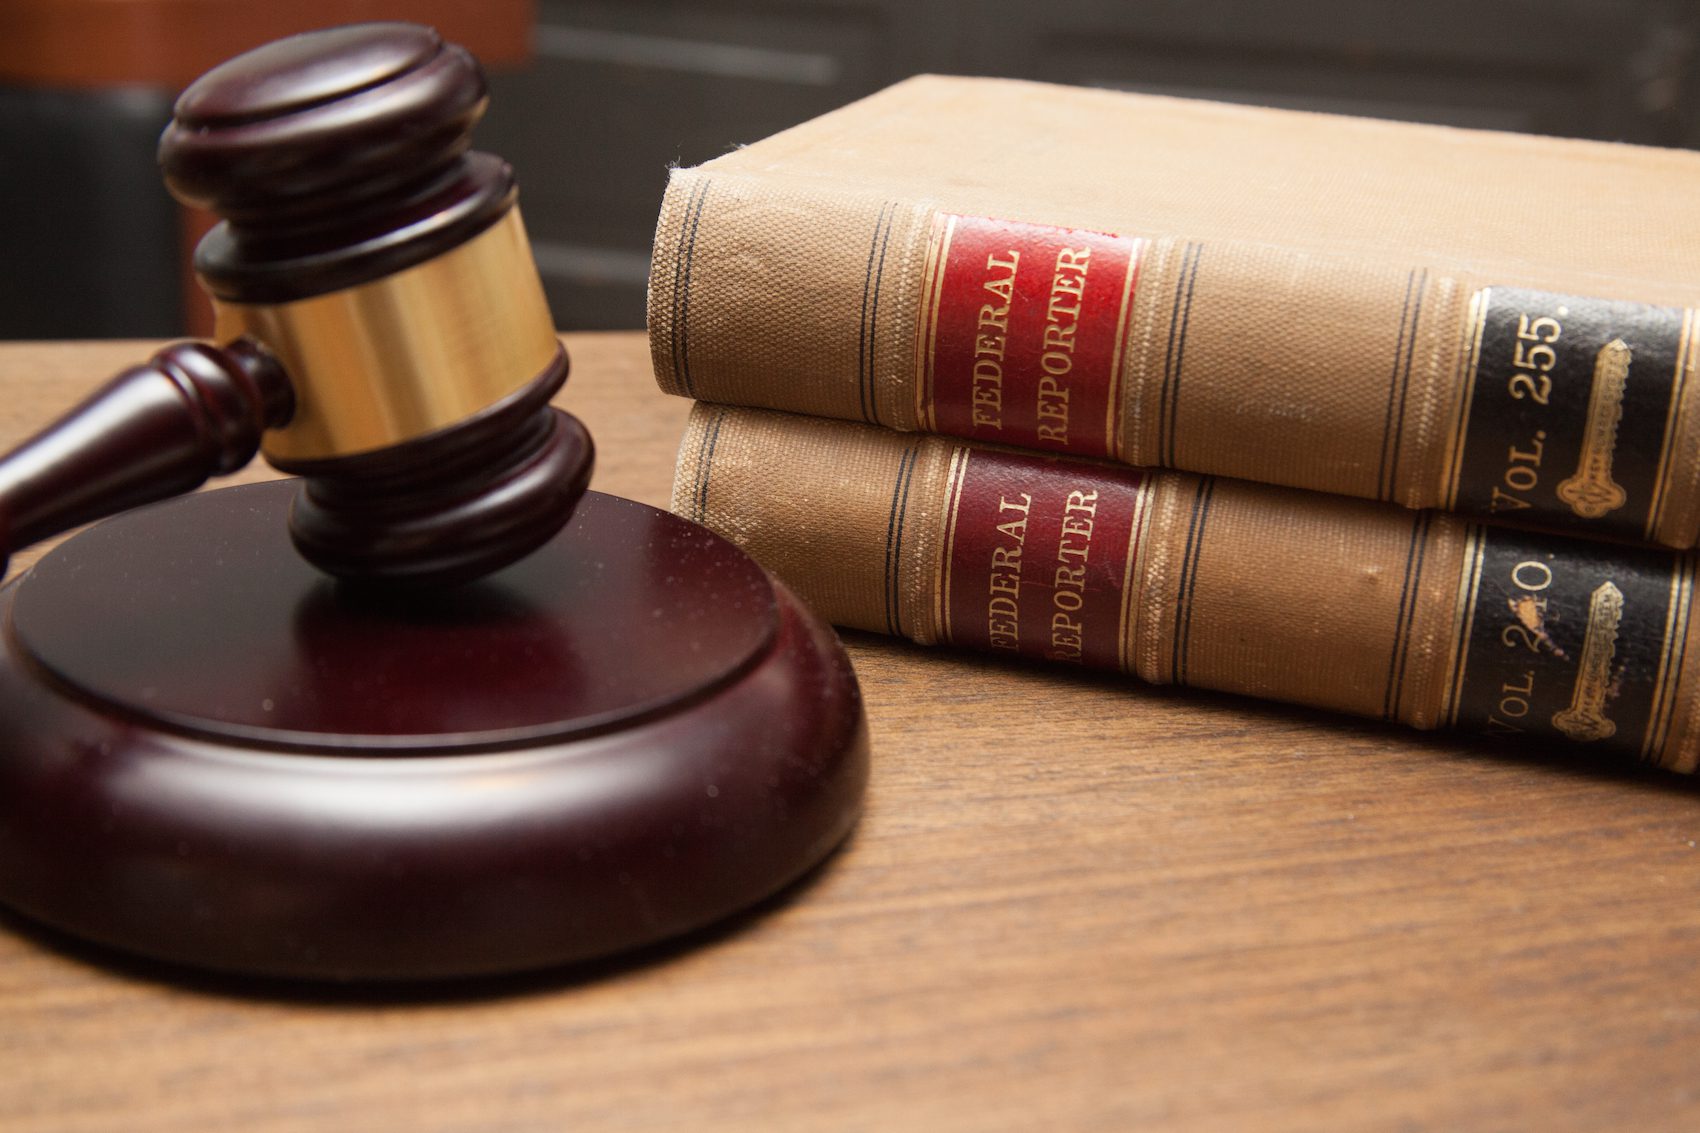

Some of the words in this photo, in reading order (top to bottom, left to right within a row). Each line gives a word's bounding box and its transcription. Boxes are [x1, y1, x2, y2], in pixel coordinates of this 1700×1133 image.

[972, 249, 1021, 431] FEDERAL
[1036, 246, 1093, 446] REPORTER
[1489, 430, 1547, 514] VOL.
[988, 492, 1032, 651] FEDERAL
[1051, 489, 1099, 665] REPORTER
